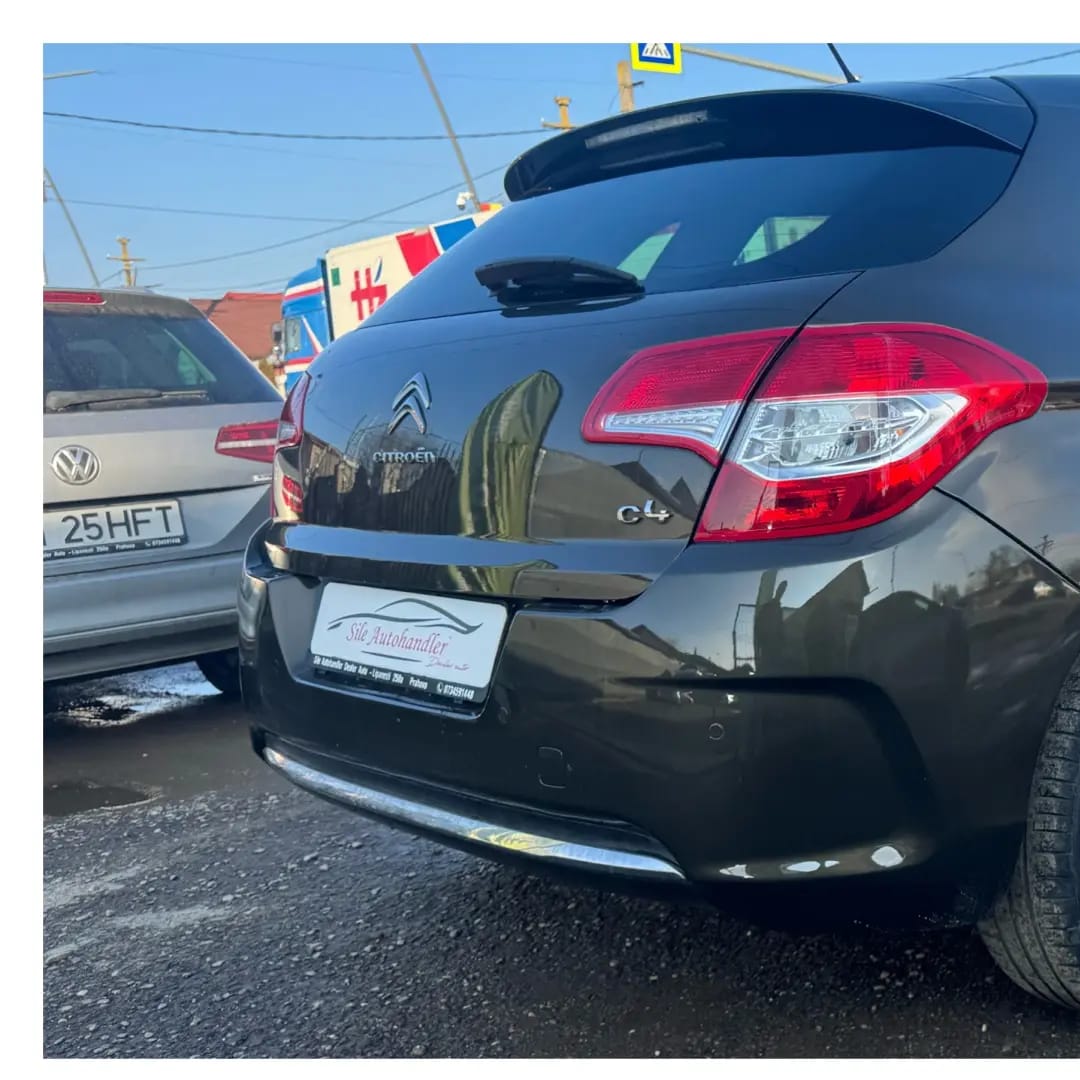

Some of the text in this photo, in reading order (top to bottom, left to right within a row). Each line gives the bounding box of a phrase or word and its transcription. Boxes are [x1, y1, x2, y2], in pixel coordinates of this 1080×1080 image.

[616, 499, 670, 524] C4
[346, 622, 448, 655] Sile Autohandler
